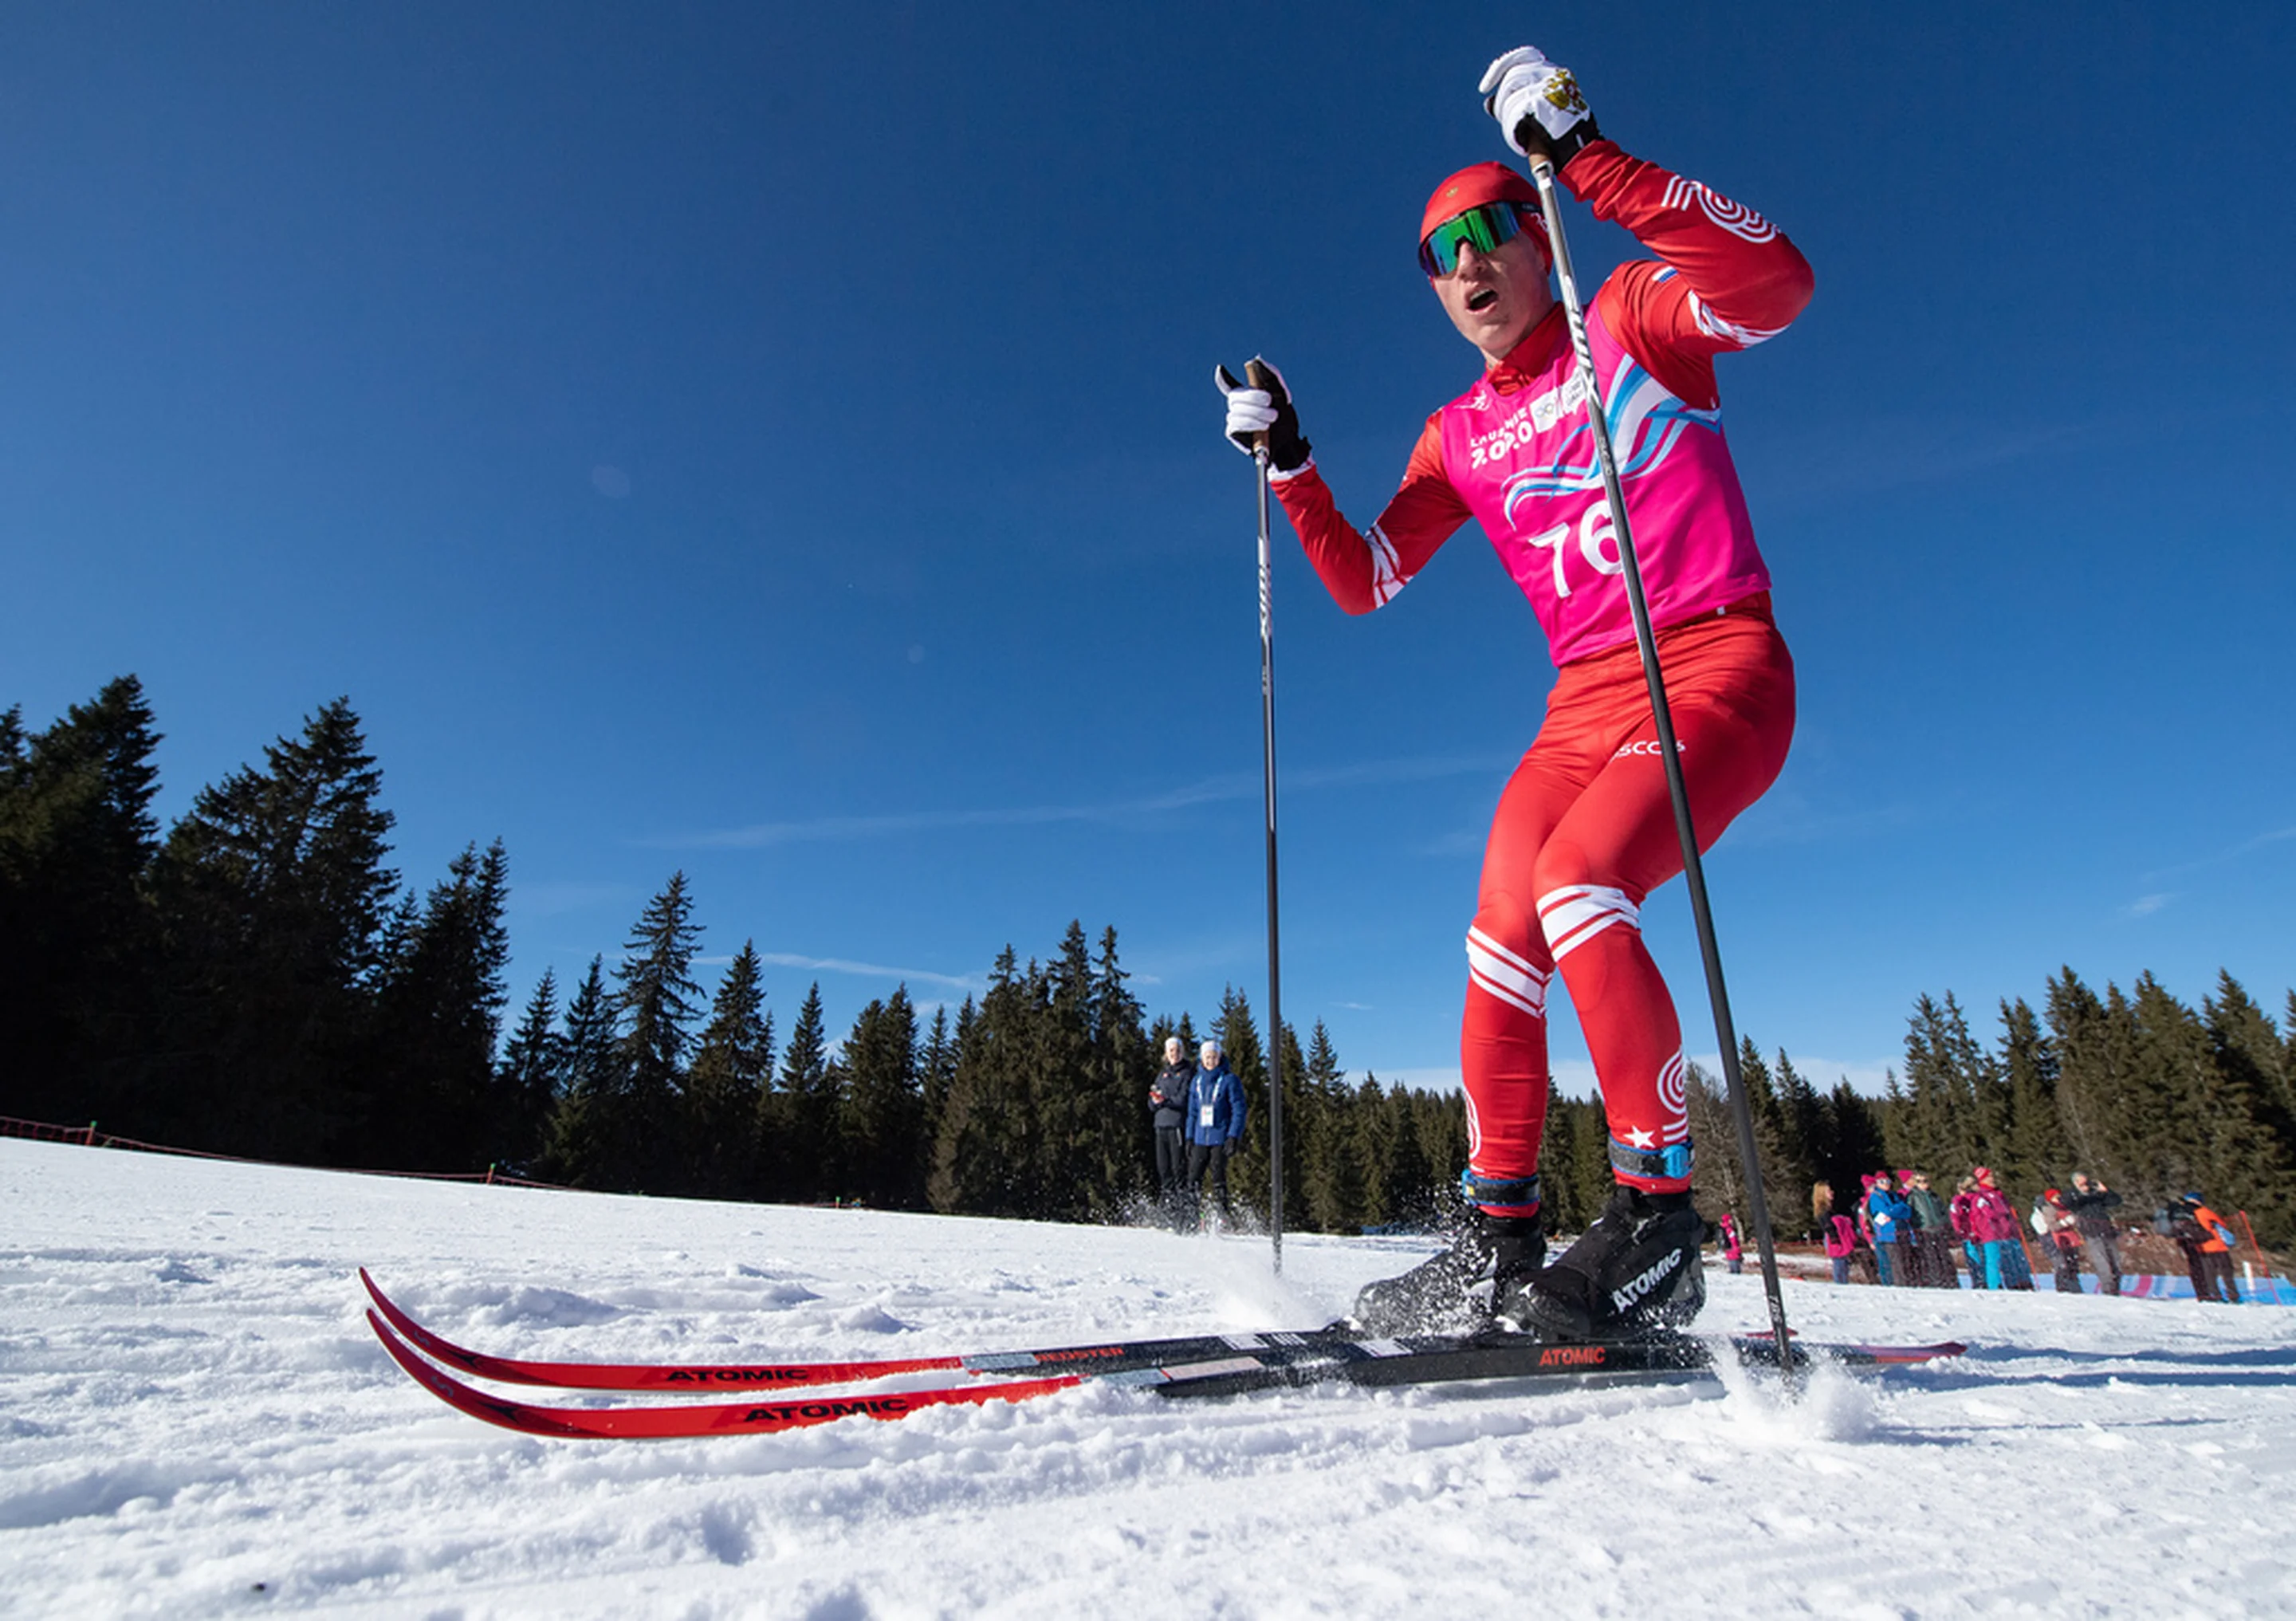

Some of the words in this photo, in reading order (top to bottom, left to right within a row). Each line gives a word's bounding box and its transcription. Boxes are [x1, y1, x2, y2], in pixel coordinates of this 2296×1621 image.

[1470, 420, 1534, 470] 2020
[1527, 499, 1624, 599] 76
[1610, 1247, 1683, 1313] ATOMIC
[1539, 1347, 1606, 1367] ATOMIC
[666, 1369, 809, 1382] ATOMIC
[744, 1399, 909, 1422] ATOMIC
